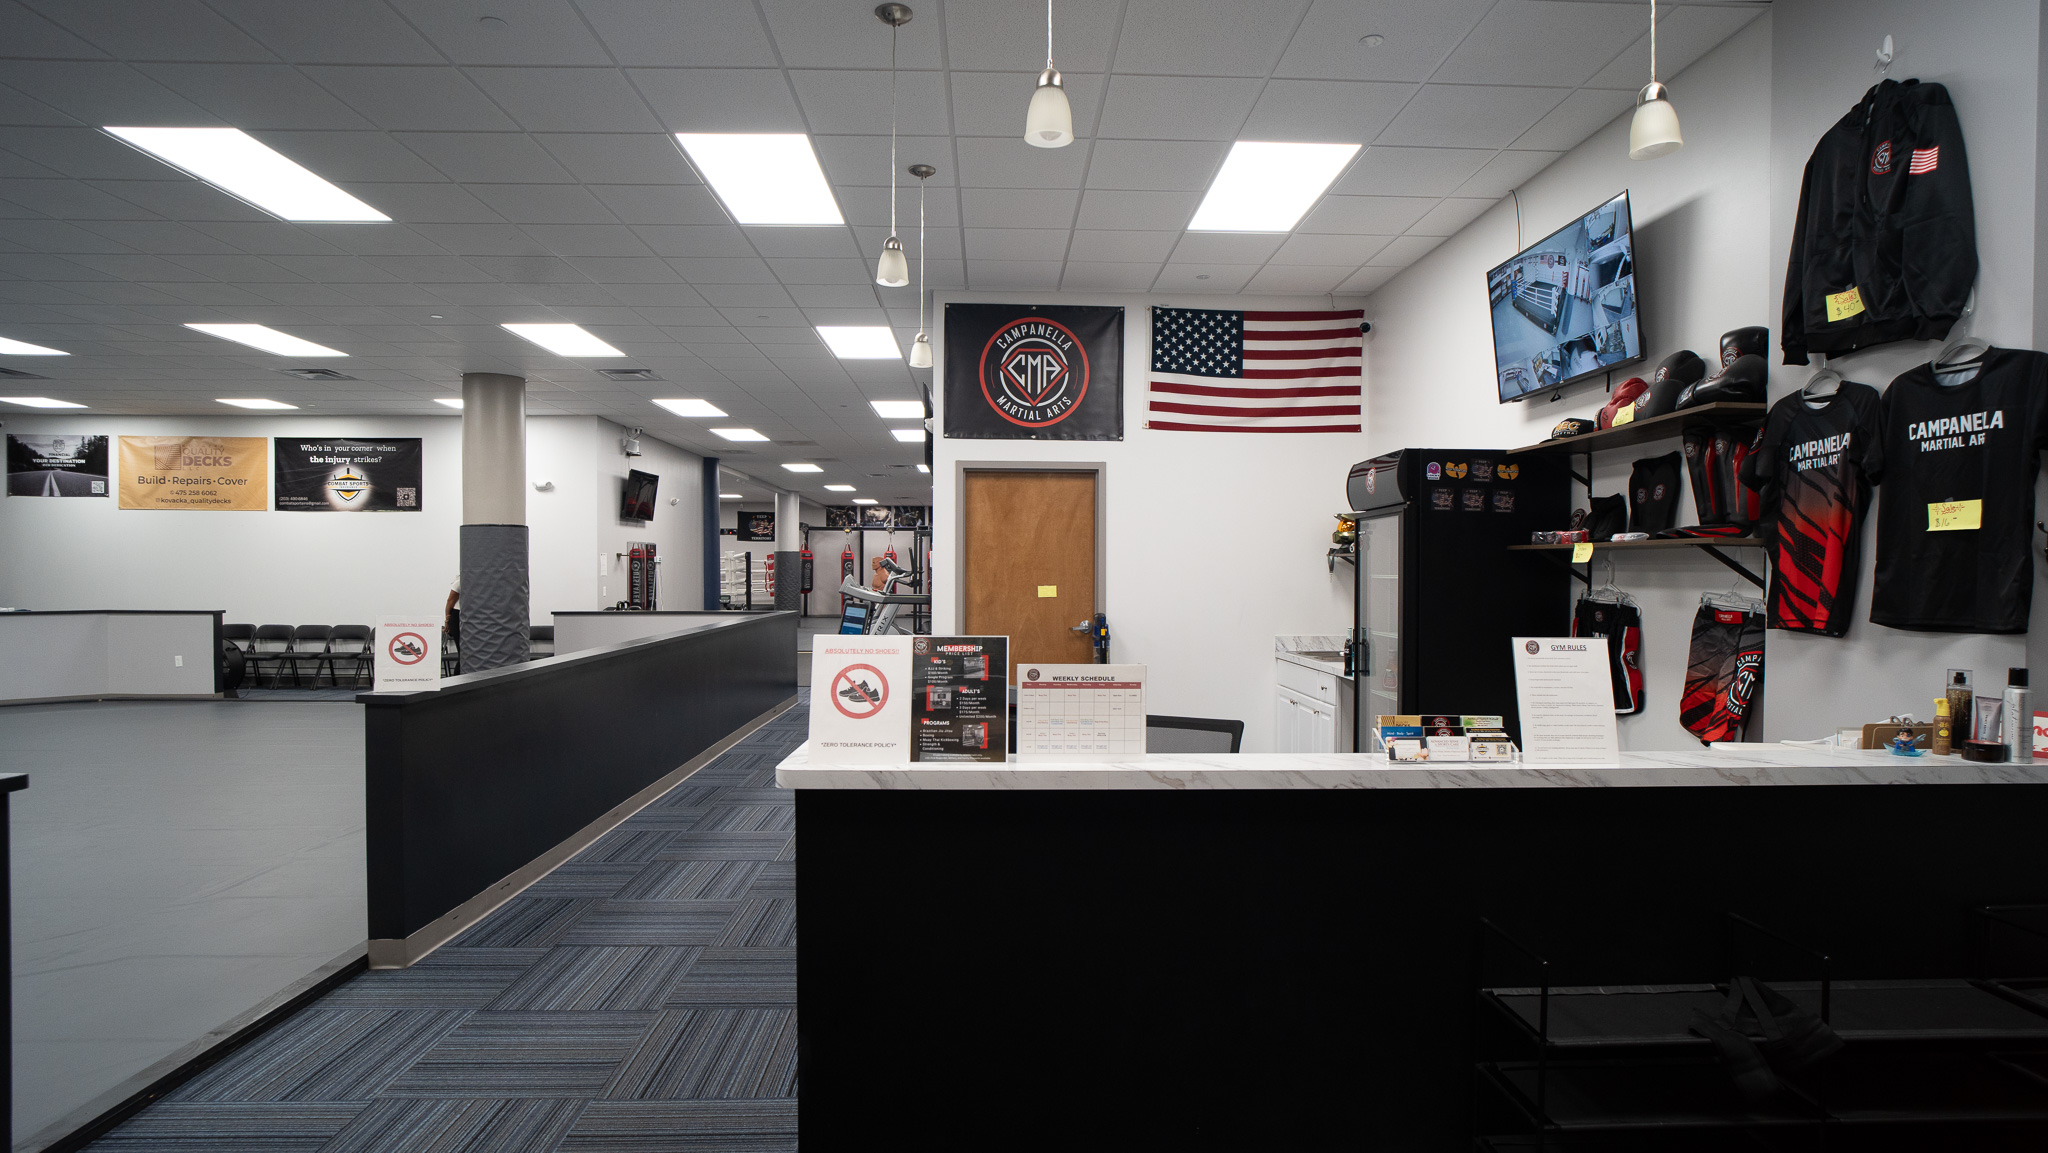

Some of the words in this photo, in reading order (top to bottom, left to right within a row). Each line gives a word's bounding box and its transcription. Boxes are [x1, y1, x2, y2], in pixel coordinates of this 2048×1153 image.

[996, 324, 1073, 351] CAMPANELLA
[1007, 354, 1062, 395] CMA
[997, 395, 1041, 421] MARTIAL
[1047, 396, 1072, 418] ARTS
[1921, 435, 1965, 453] MARTIAL
[182, 456, 232, 467] DECKS
[325, 456, 351, 464] injury
[1797, 456, 1828, 472] MARTIAL
[138, 476, 166, 484] Build
[172, 476, 212, 486] Repairs
[217, 477, 248, 486] Cover
